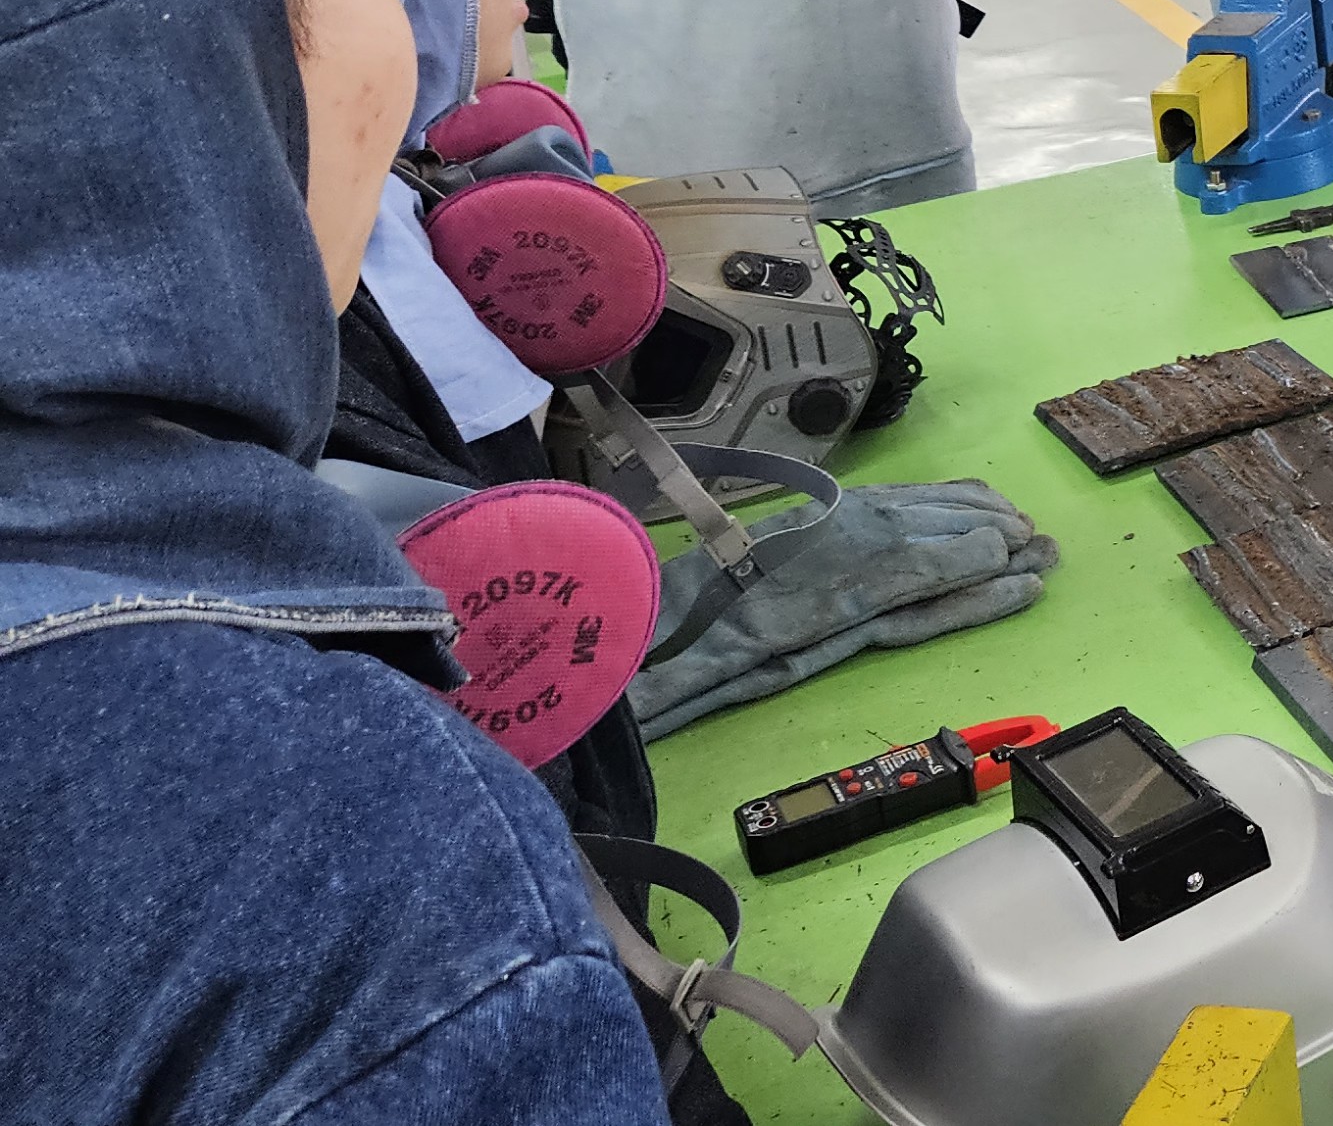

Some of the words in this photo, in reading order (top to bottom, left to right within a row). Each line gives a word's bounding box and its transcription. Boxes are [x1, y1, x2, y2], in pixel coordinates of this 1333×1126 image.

[511, 230, 600, 275] 2097K
[461, 570, 584, 621] 2097K
[569, 615, 603, 665] 3M
